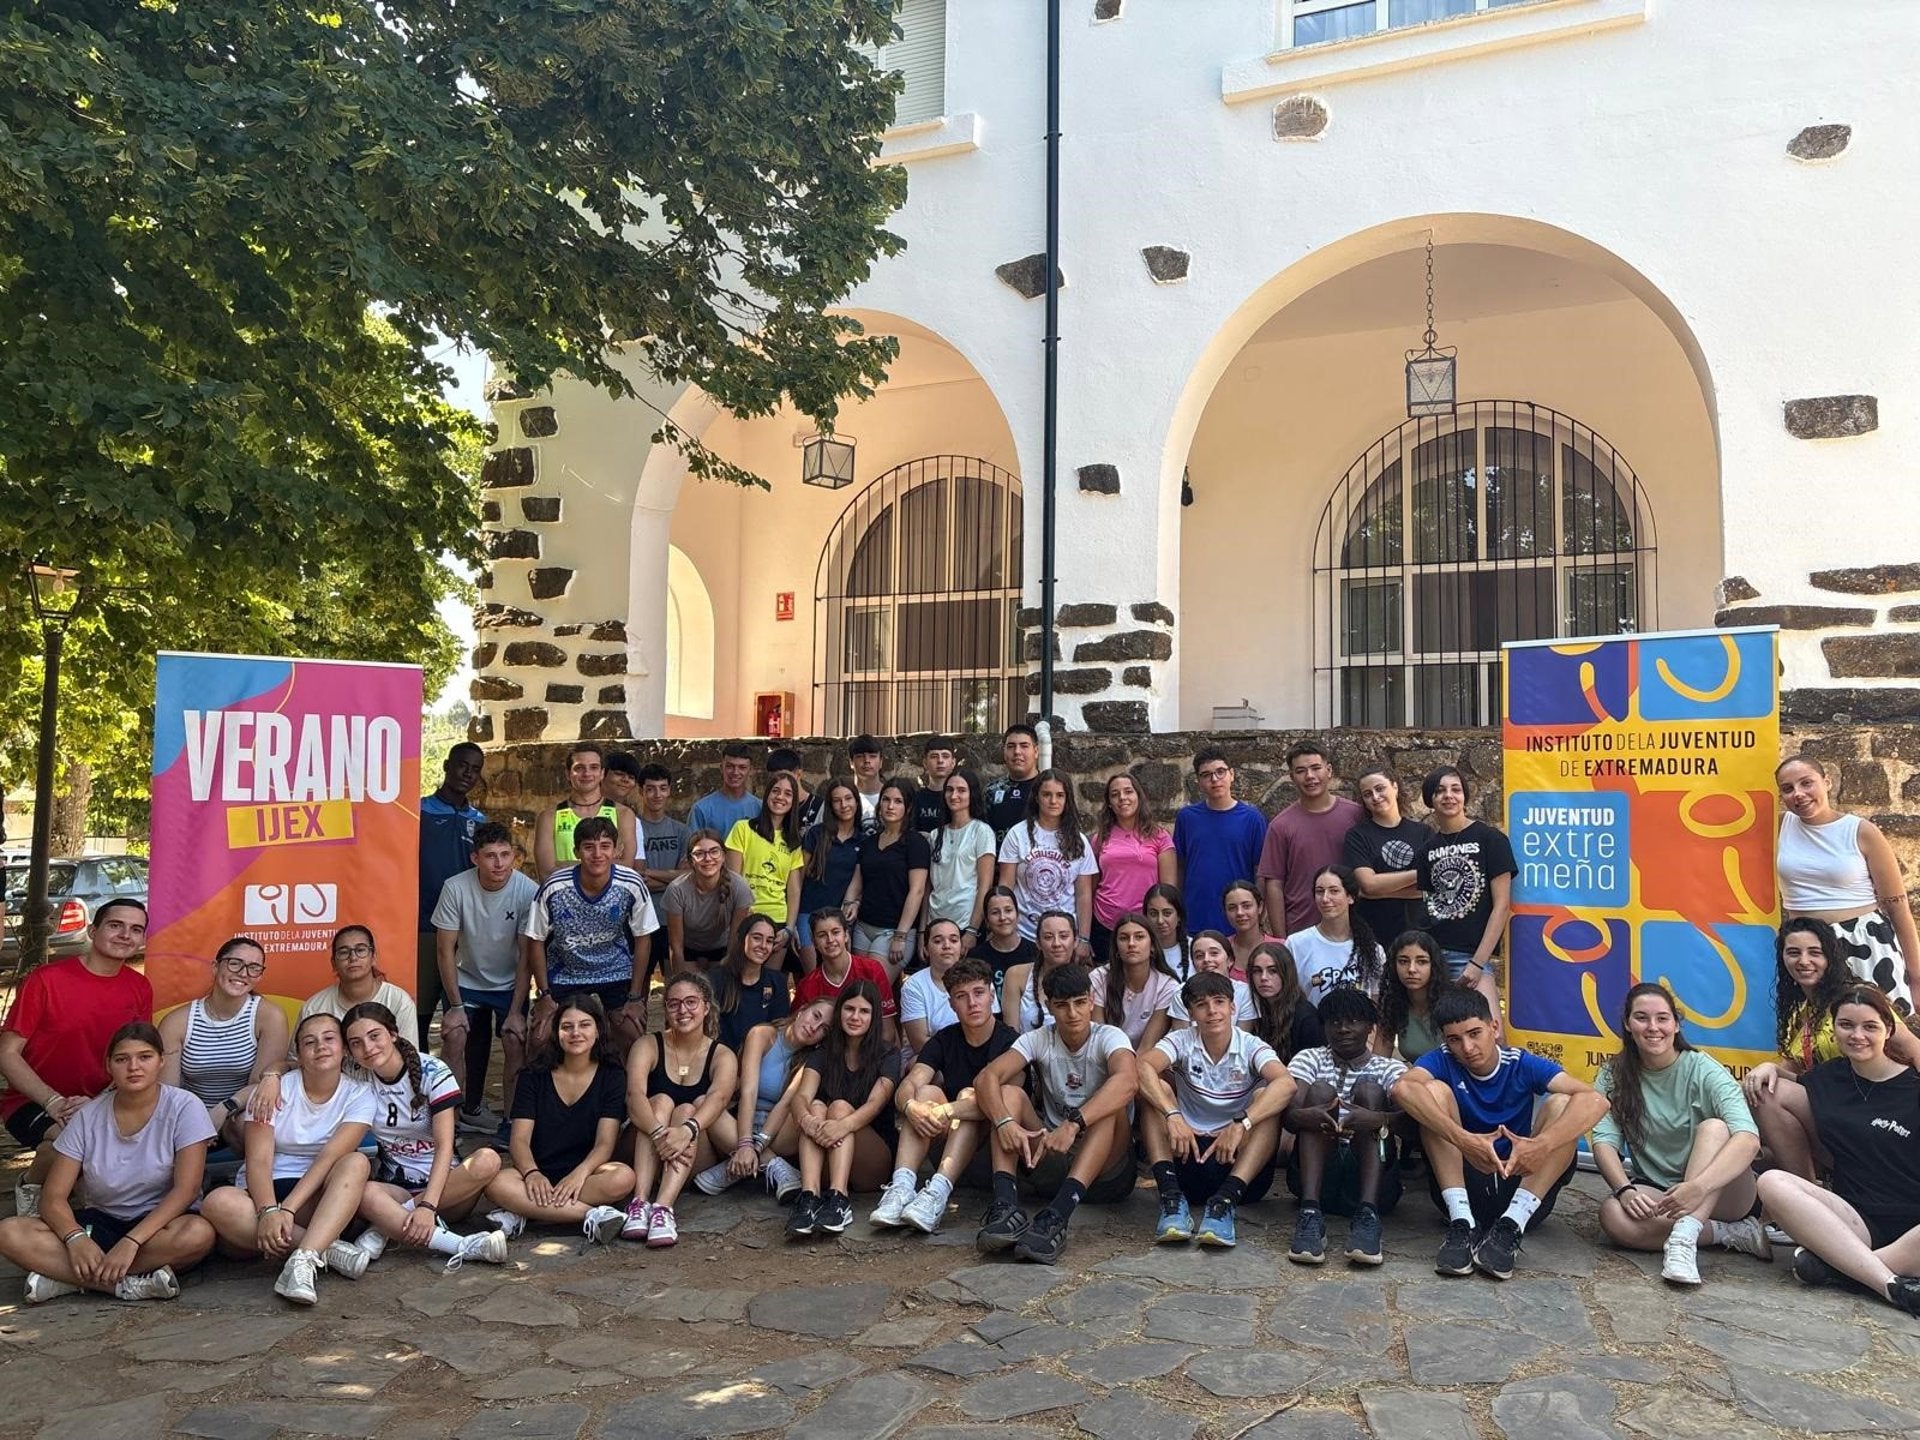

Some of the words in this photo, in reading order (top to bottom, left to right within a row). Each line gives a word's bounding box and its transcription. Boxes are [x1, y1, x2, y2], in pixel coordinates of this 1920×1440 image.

[1526, 734, 1613, 752] INSTITUTO
[1659, 730, 1756, 750] JUVENTUD
[183, 710, 402, 803] VERANO
[1560, 760, 1579, 777] DE
[1584, 758, 1719, 776] EXTREMADURA
[256, 804, 325, 842] IJEX
[1523, 807, 1615, 827] JUVENTUD
[1428, 842, 1480, 862] RAMONES
[1523, 829, 1615, 858] extre
[1523, 859, 1615, 890] meña
[301, 929, 337, 940] JUVENT
[264, 942, 327, 953] EXTREMADURA
[387, 1103, 398, 1127] 8
